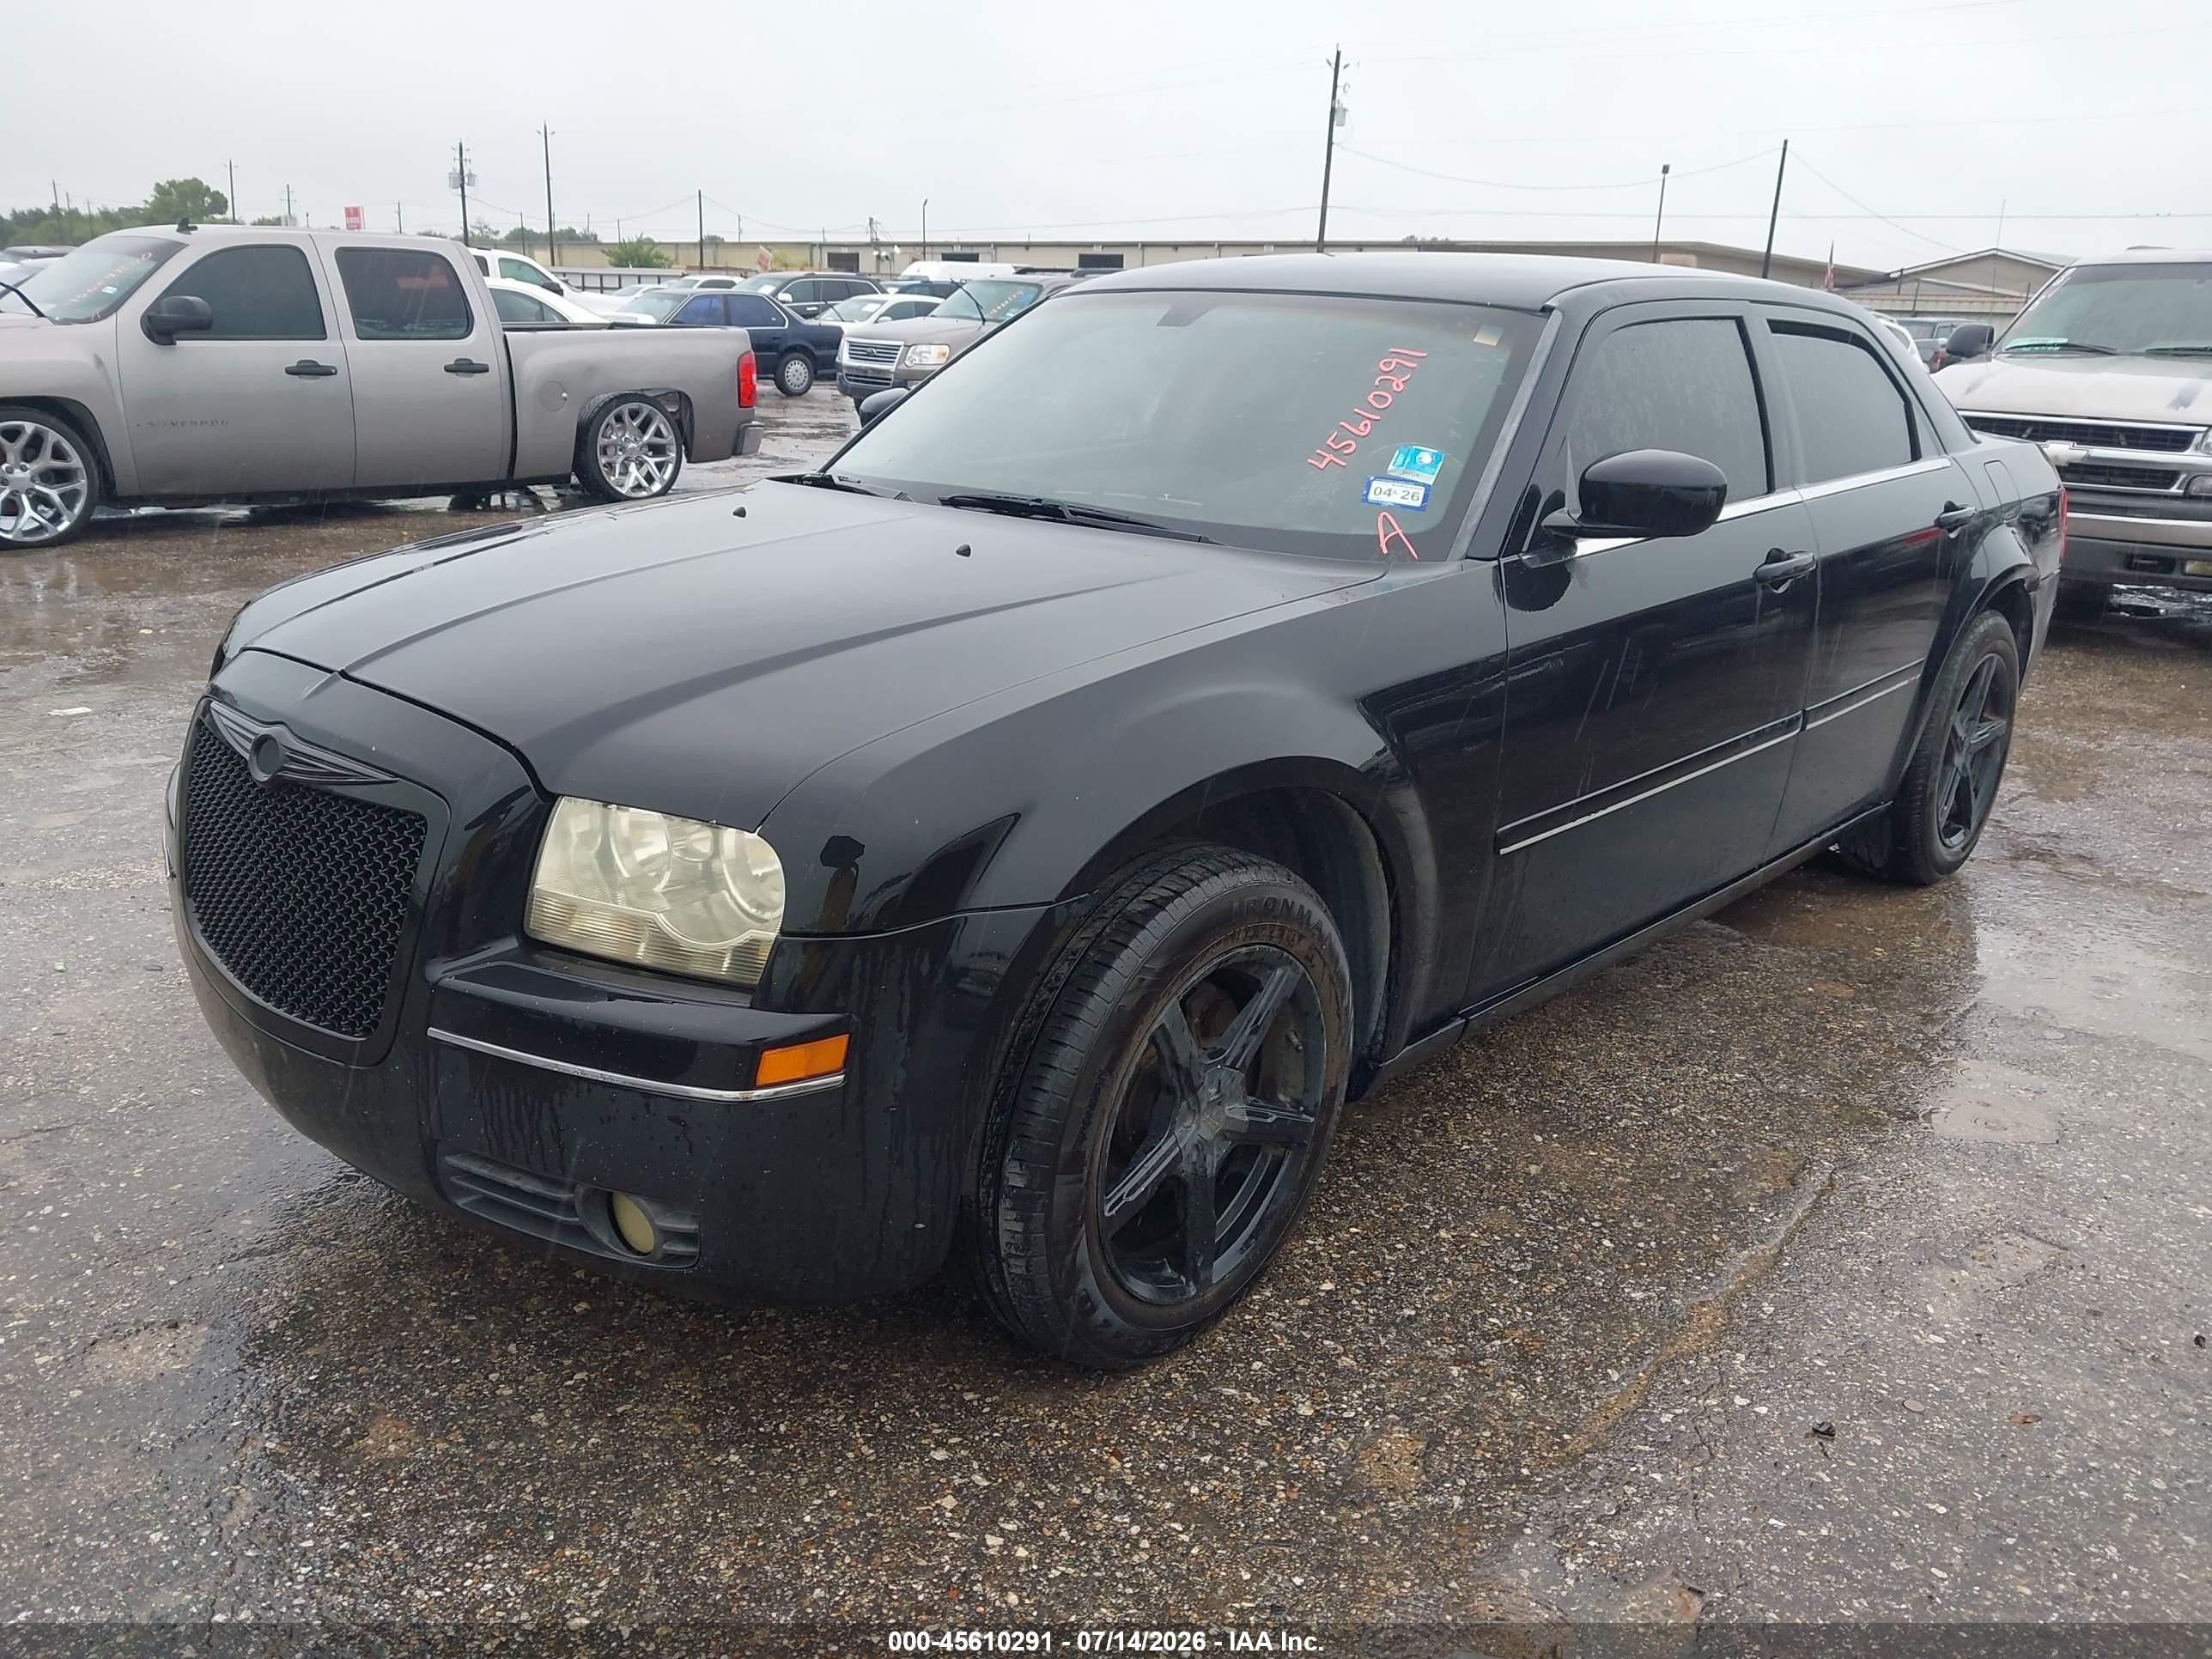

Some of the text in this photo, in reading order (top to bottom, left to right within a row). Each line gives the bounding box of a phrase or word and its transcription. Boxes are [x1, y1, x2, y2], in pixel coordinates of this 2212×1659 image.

[1307, 347, 1429, 471] 45610291
[1374, 486, 1393, 498] 04
[1400, 489, 1420, 501] 26
[1377, 511, 1419, 561] A
